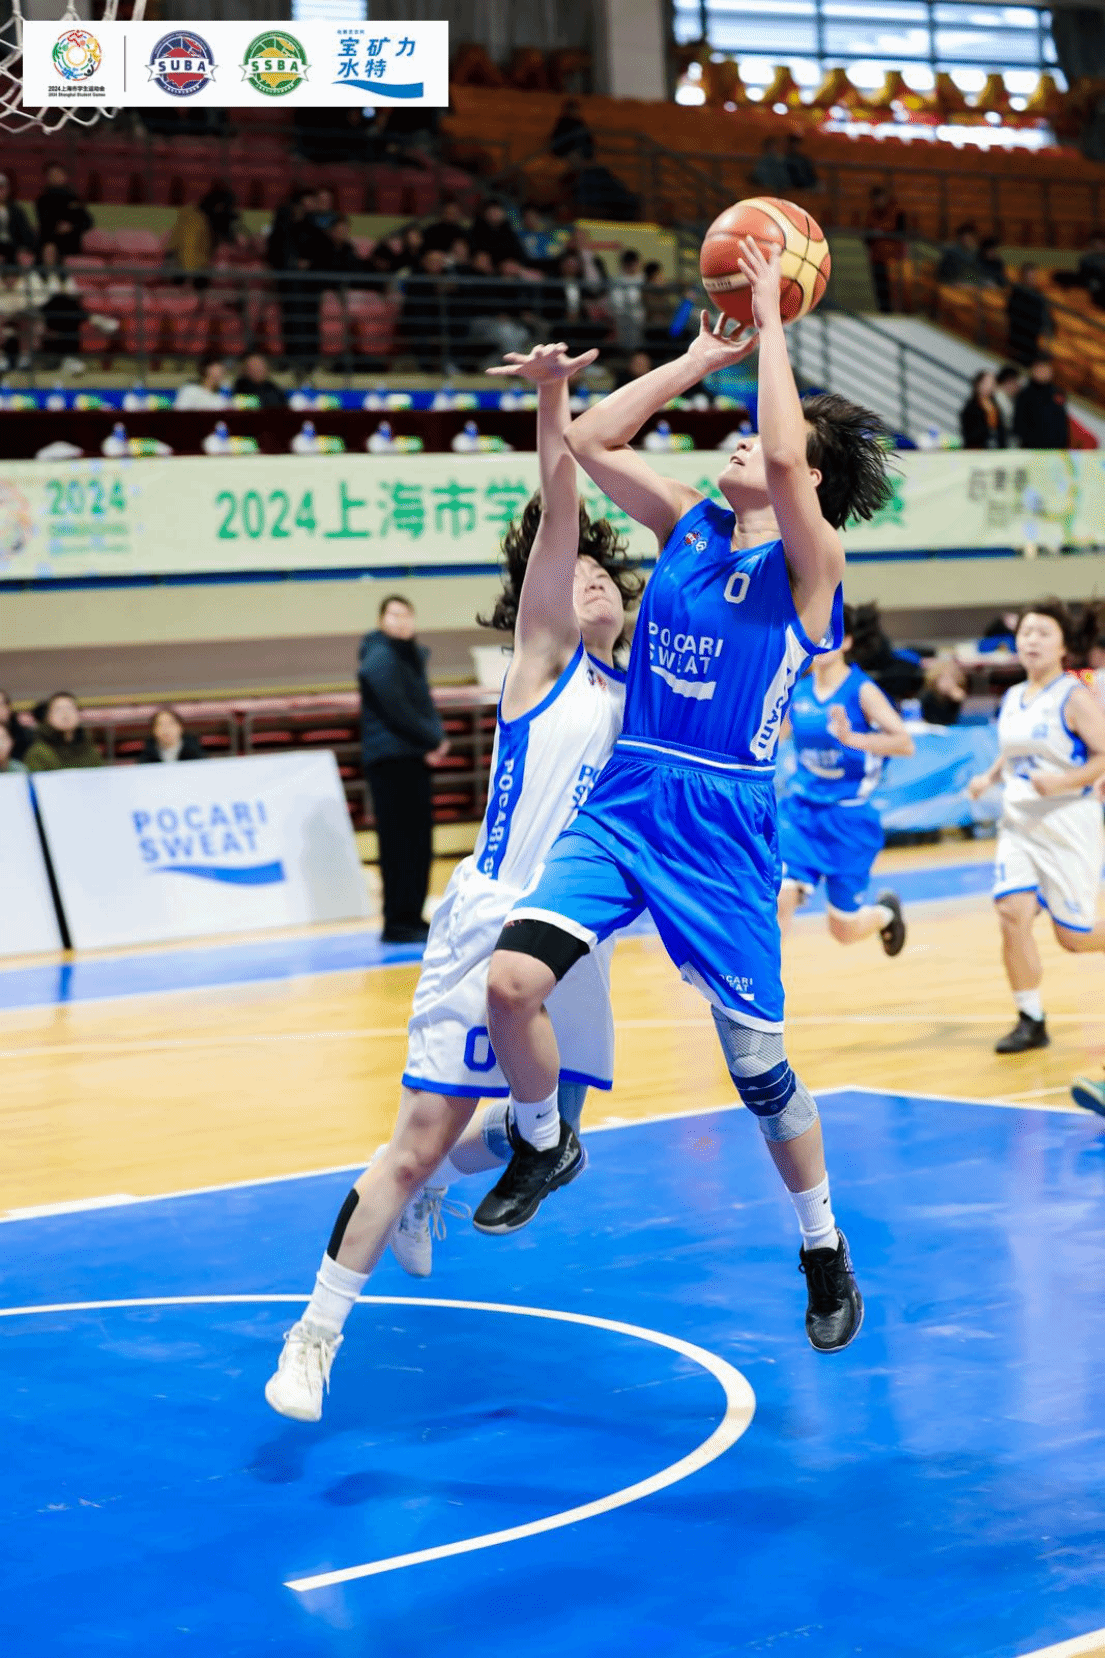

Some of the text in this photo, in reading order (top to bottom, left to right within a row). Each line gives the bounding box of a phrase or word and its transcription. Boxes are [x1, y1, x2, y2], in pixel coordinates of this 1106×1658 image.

[45, 478, 127, 516] 2024
[724, 572, 750, 604] 0
[648, 620, 724, 658] POCARI
[131, 800, 269, 835] POCARI
[138, 828, 258, 864] SWEAT
